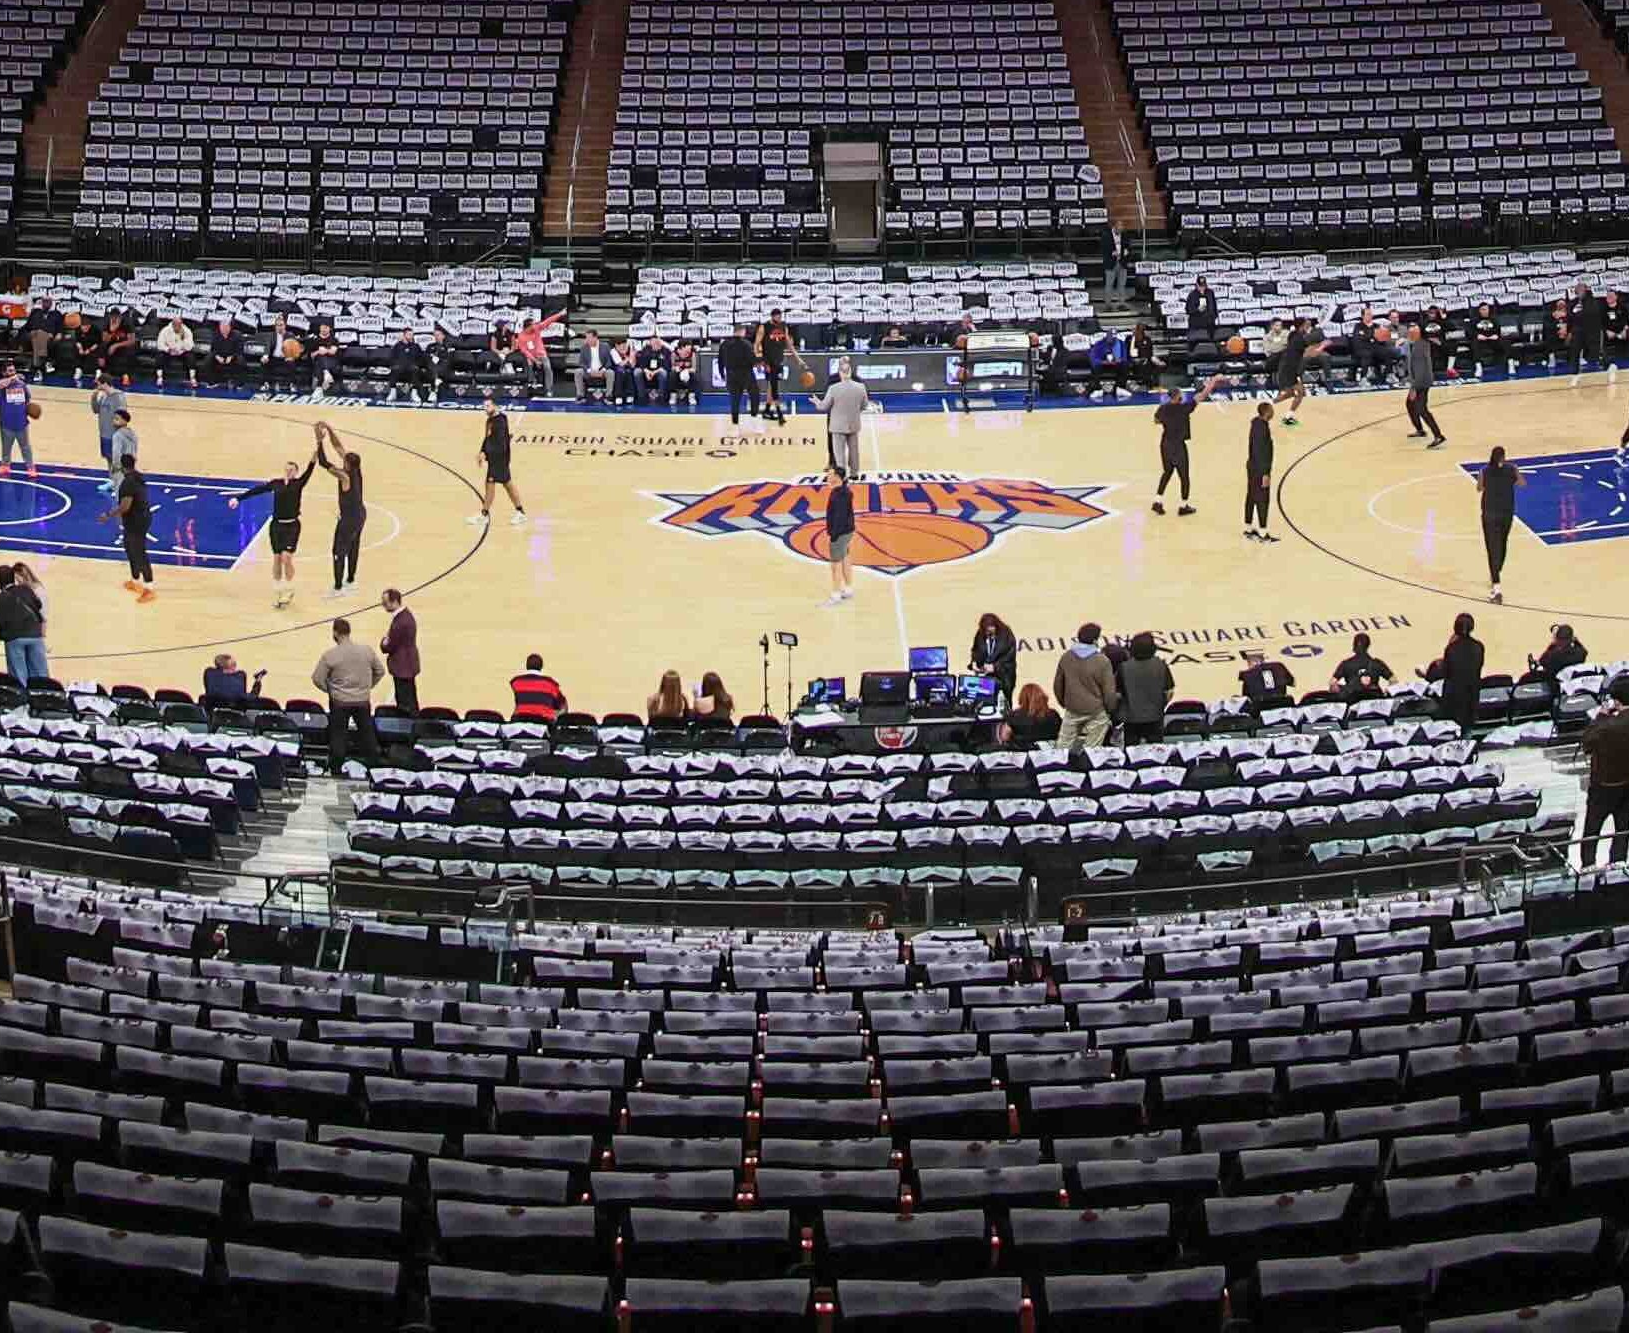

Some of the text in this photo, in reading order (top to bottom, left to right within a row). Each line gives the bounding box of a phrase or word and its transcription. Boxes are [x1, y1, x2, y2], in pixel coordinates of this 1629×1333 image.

[509, 435, 817, 447] ADISON SQUARE GARDEN
[564, 448, 696, 459] CHASE
[880, 473, 961, 483] YORK
[663, 479, 1109, 527] KNICKS
[1282, 613, 1412, 637] GARDEN
